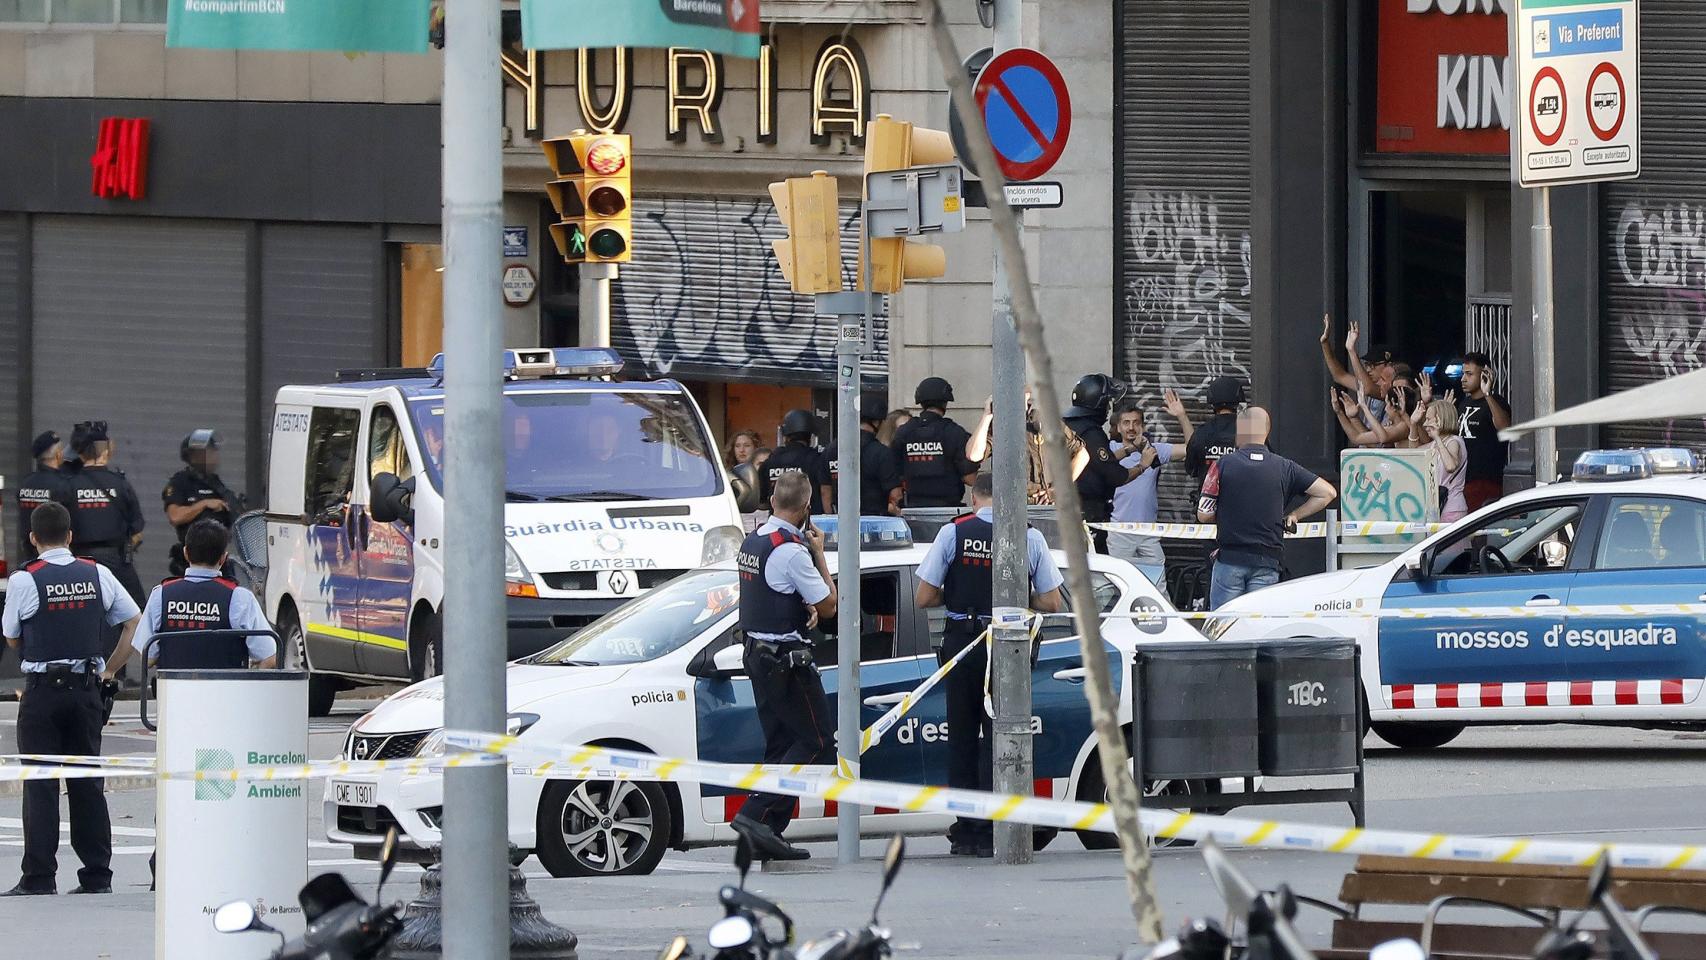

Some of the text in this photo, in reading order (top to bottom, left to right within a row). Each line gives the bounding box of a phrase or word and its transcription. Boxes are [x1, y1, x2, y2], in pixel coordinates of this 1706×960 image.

[1558, 22, 1621, 44] Via Preferent
[1436, 54, 1510, 131] KIN
[1027, 187, 1048, 195] motos
[275, 412, 308, 432] ATESTATS
[905, 441, 943, 452] POLICIA
[1205, 445, 1236, 456] OLIC
[19, 488, 50, 498] POLICIA
[77, 488, 118, 499] POLICA
[503, 517, 704, 539] Guàrdia Urbana
[963, 538, 993, 554] POLI
[738, 551, 761, 568] POLICIA
[46, 581, 97, 597] POLICIA
[168, 601, 221, 616] POLICIA
[167, 613, 189, 621] mossos
[1436, 623, 1677, 651] mossos d'esquadra
[631, 690, 674, 706] policia
[247, 751, 306, 765] Barcelona
[247, 784, 302, 799] Ambient
[355, 785, 373, 804] 1901
[270, 906, 279, 914] de
